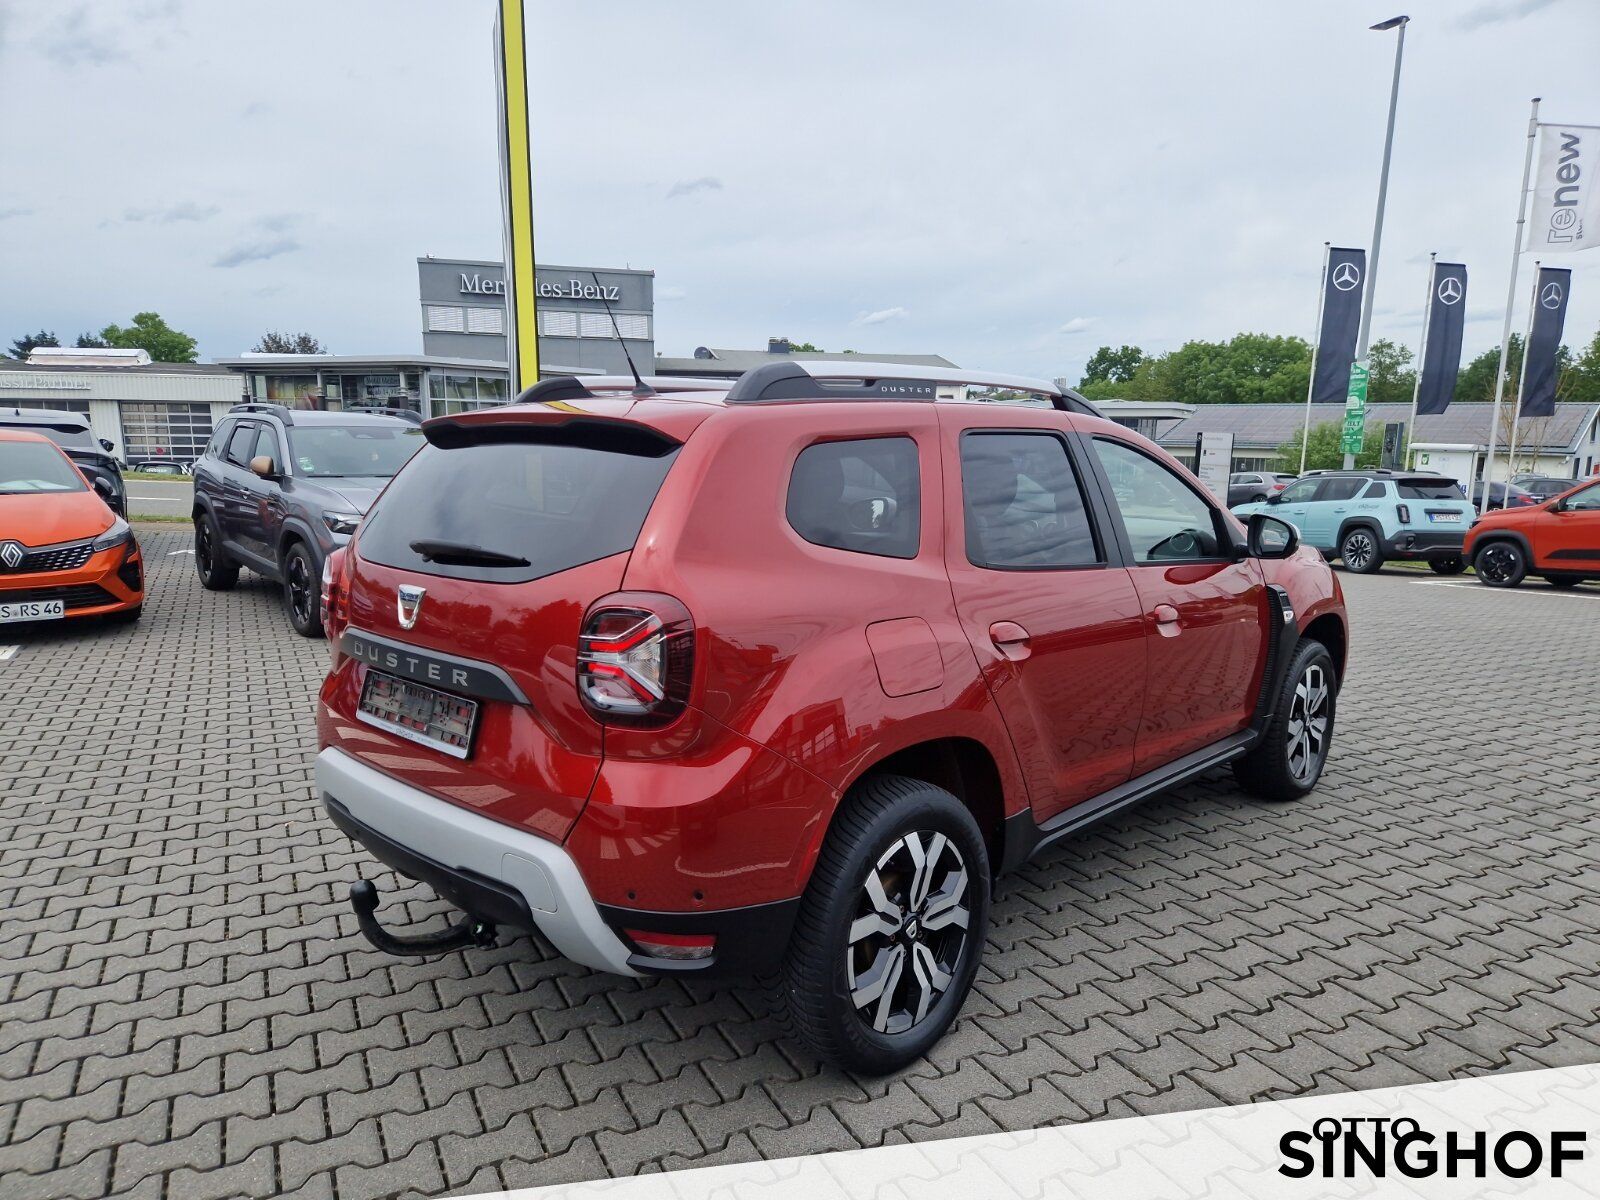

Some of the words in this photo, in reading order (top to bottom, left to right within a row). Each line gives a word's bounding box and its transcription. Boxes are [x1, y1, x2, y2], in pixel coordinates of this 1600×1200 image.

[1547, 132, 1581, 243] renew
[20, 604, 40, 616] RS
[43, 602, 62, 615] 46
[354, 641, 469, 687] DUSTER
